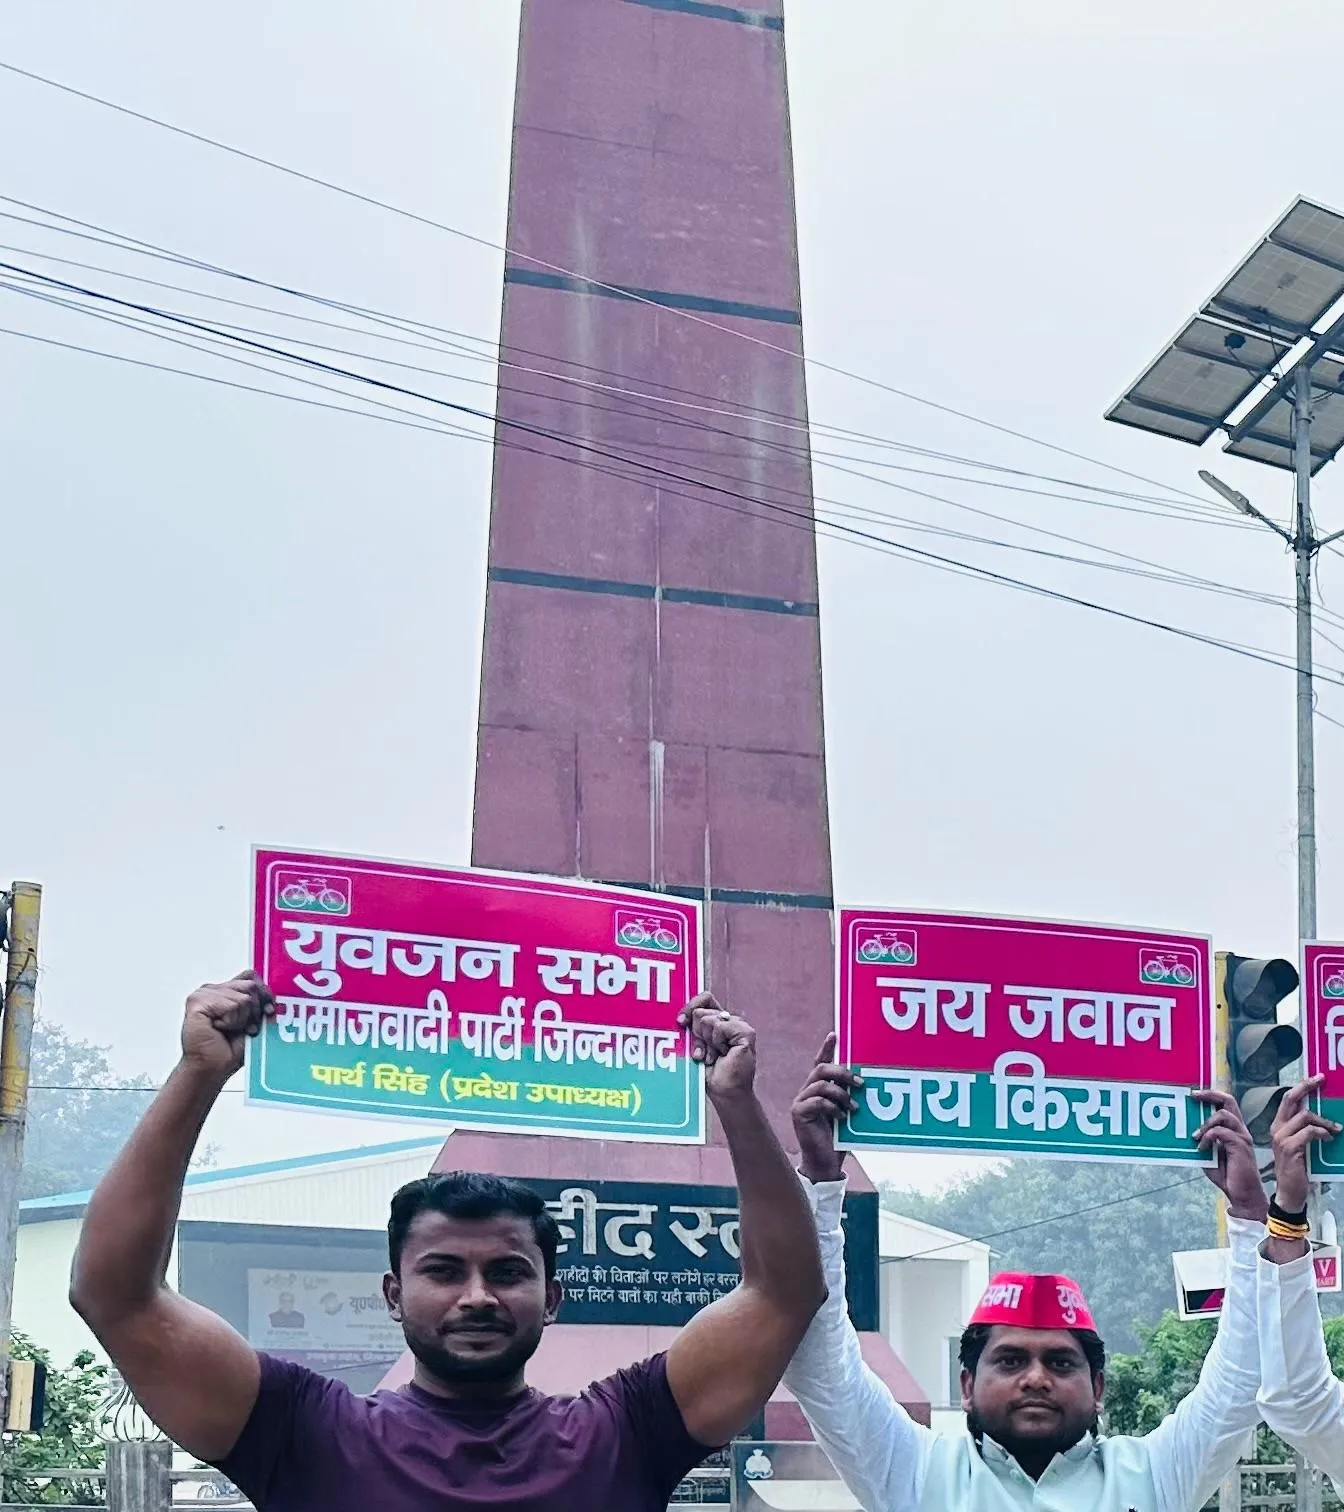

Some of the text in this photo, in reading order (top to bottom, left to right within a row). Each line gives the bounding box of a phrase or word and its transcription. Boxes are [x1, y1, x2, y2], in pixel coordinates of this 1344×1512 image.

[282, 920, 676, 1003] युवजन सभा
[276, 994, 680, 1073] समाजवादी पार्टी जिन्दाबाद
[875, 976, 1177, 1051] जय जवान
[310, 1061, 642, 1116] पार्थ सिंह (प्रदेश उपाध्यक्ष)
[860, 1050, 1193, 1140] जय किसान
[545, 1188, 658, 1260] हीद
[568, 1289, 583, 1302] पर
[643, 1289, 658, 1304] का
[661, 1289, 682, 1305] यही
[592, 1264, 607, 1284] की
[652, 1271, 669, 1285] पर
[1317, 1258, 1332, 1277] V
